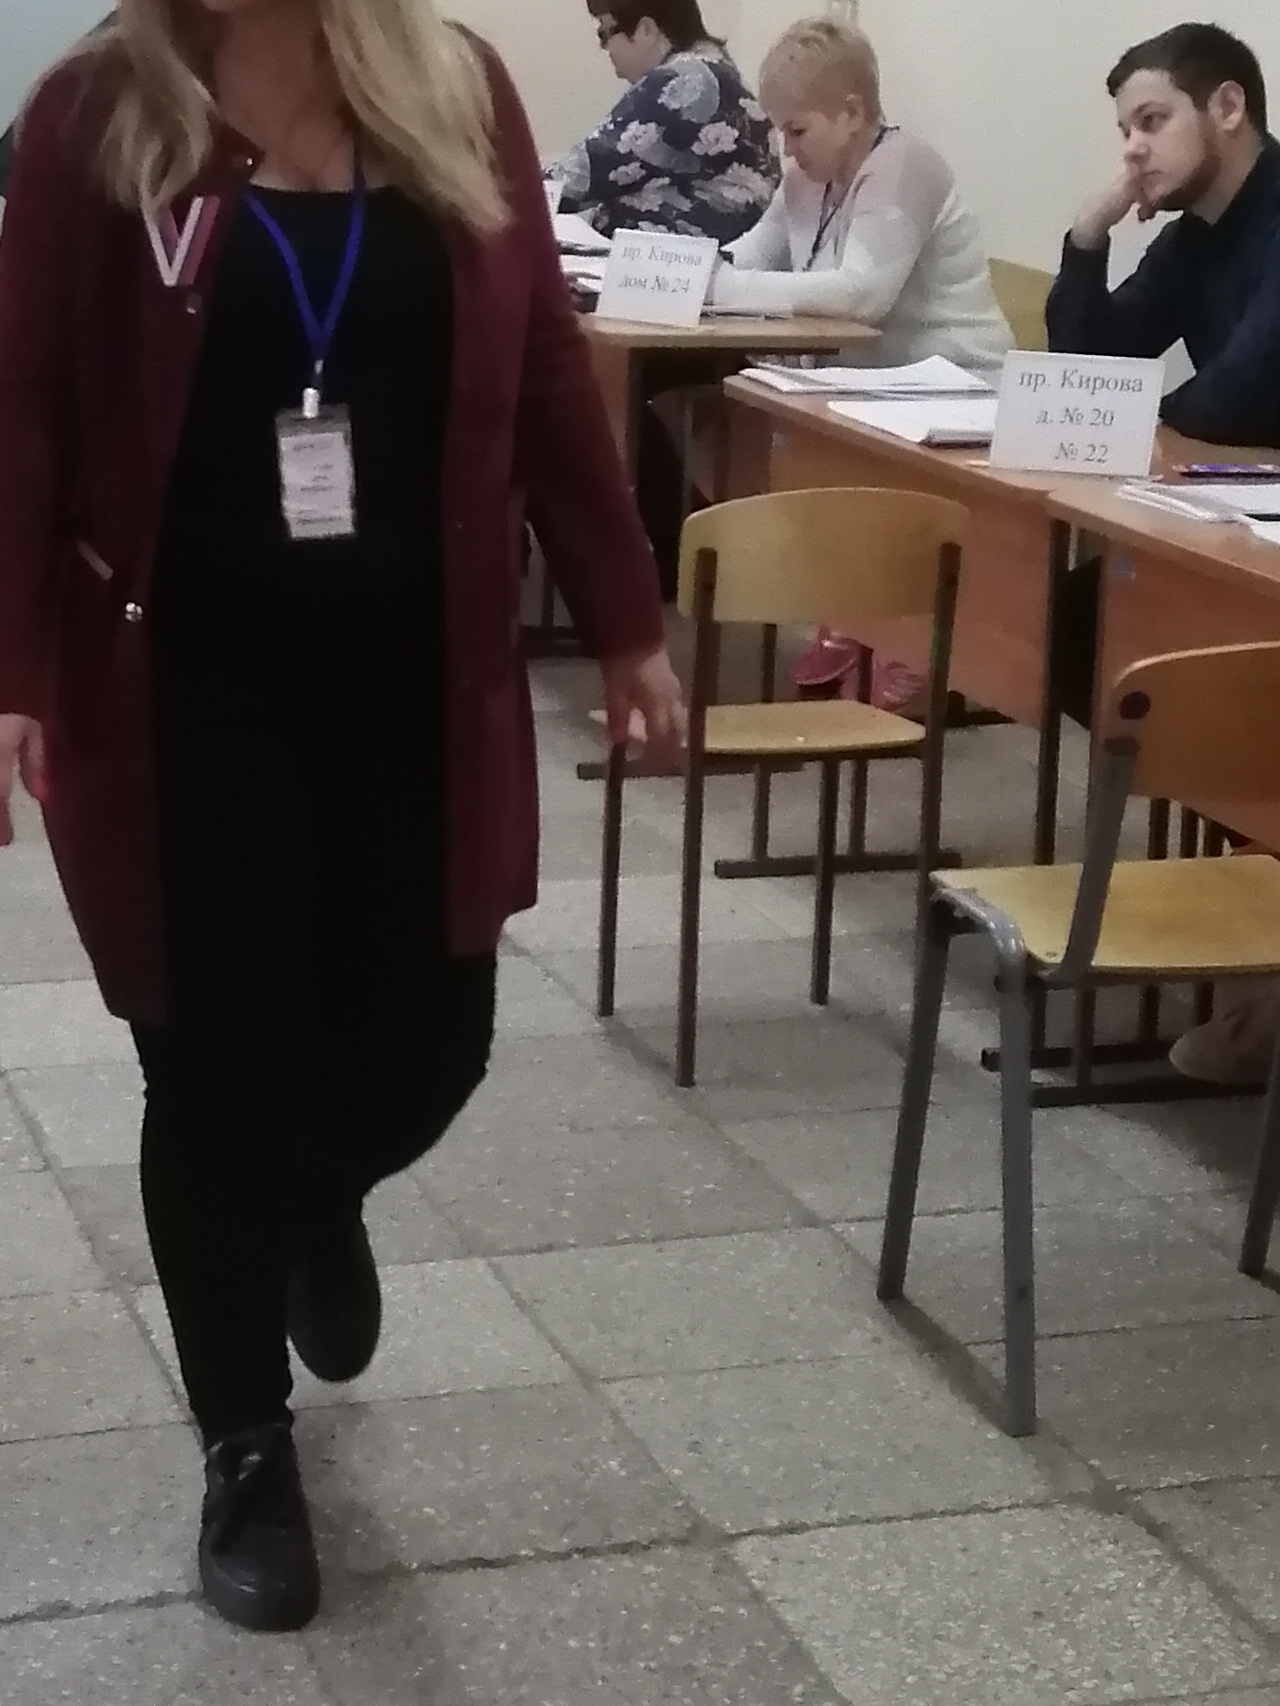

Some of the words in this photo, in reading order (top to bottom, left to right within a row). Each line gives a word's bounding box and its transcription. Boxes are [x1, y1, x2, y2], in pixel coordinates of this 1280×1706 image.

[1019, 371, 1051, 393] пр.
[1059, 367, 1144, 395] Кирова
[1035, 408, 1054, 426] д.
[1059, 406, 1084, 426] №
[1090, 407, 1115, 427] 20
[1054, 440, 1079, 461] №
[1083, 443, 1109, 464] 22
